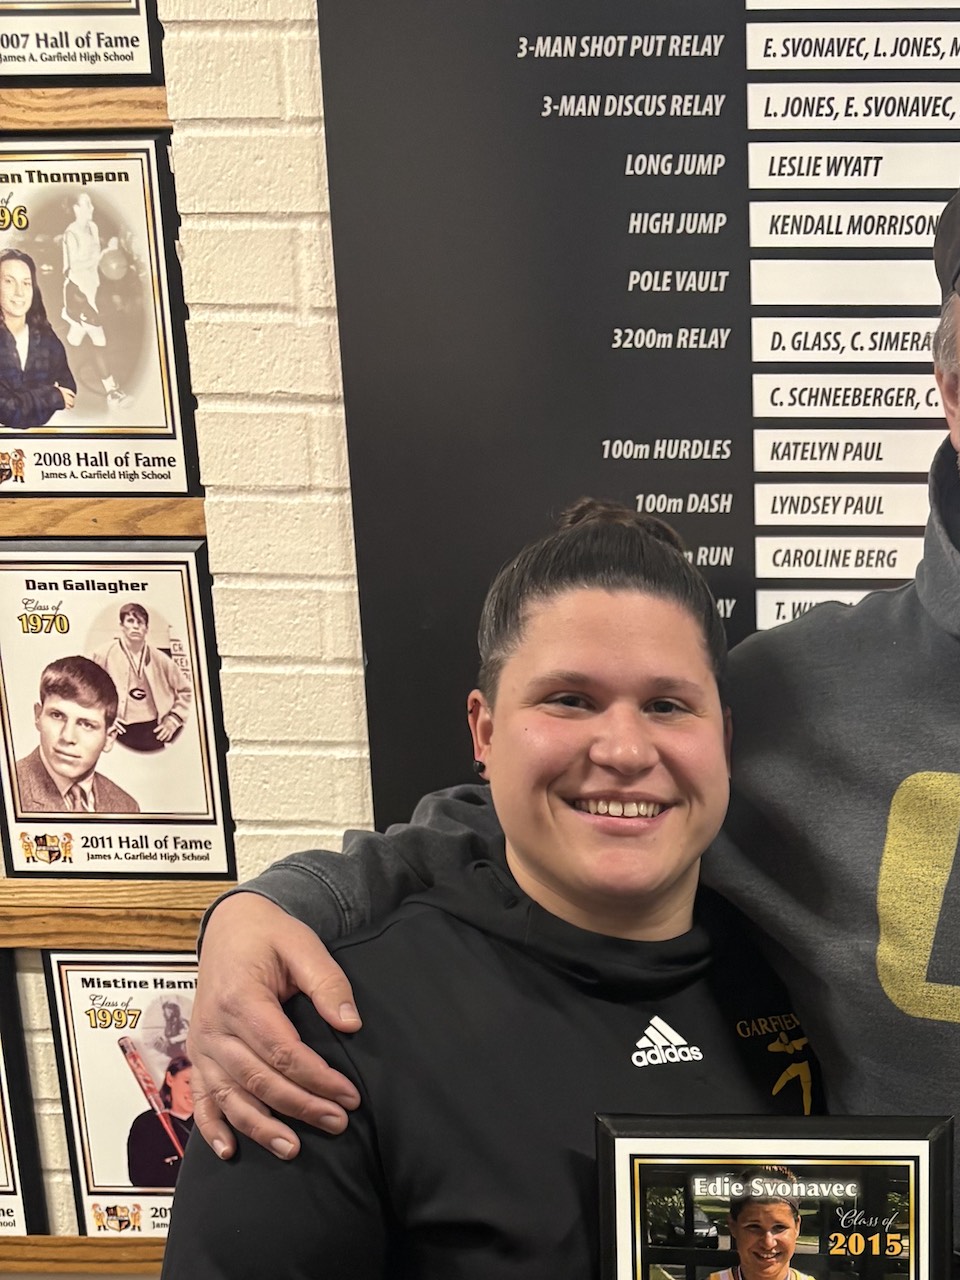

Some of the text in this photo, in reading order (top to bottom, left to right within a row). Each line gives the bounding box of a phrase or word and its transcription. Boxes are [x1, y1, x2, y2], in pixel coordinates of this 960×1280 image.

[0, 31, 140, 48] 007 Hall of Fame
[517, 34, 725, 58] 3-MAN SHOT PUT RELAY
[763, 38, 777, 58] E.
[781, 37, 869, 60] SVONAVEC,
[874, 37, 887, 58] L.
[890, 37, 946, 60] JONES,
[28, 52, 38, 62] A.
[40, 52, 77, 62] Garfield
[80, 52, 100, 64] High
[104, 52, 134, 62] School
[541, 94, 726, 117] 3-MAN DISCUS RELAY
[764, 97, 778, 117] L.
[782, 96, 840, 120] JONES,
[844, 97, 859, 117] E.
[863, 96, 956, 120] SVONAVEC,
[624, 154, 726, 176] LONG JUMP
[768, 156, 883, 177] LESLIE WYATT
[25, 170, 130, 185] Thompson
[628, 212, 727, 234] HIGH JUMP
[769, 214, 844, 236] KENDALL
[628, 270, 730, 292] POLE VAULT
[612, 328, 731, 349] 3200m RELAY
[770, 332, 787, 351] D.
[791, 332, 846, 354] GLASS,
[850, 332, 864, 351] C.
[770, 387, 940, 410] C. SCHNEEBERGER, C.
[601, 439, 732, 460] 100m HURDLES
[770, 442, 884, 461] KATELYN PAUL
[33, 452, 177, 468] 2008 Hall of Fame
[41, 470, 171, 482] James A. Garfield High School
[635, 494, 733, 514] 100m DASH
[770, 496, 884, 515] LYNDSEY PAUL
[696, 547, 734, 566] RUN
[772, 549, 898, 568] CAROLINE BERG
[25, 579, 148, 593] Dan Gallagher
[22, 598, 63, 614] Class of
[775, 602, 787, 621] T.
[18, 613, 70, 634] 1970
[81, 836, 212, 850] 2011 Hall of Fame
[86, 852, 210, 863] James A. Garfield High School
[81, 978, 149, 989] Mistine
[89, 994, 134, 1010] Class of
[85, 1008, 142, 1029] 1997
[631, 1044, 704, 1068] adidas
[693, 1178, 858, 1197] Edie Svonavec
[836, 1207, 899, 1232] Class of
[829, 1232, 903, 1256] 2015
